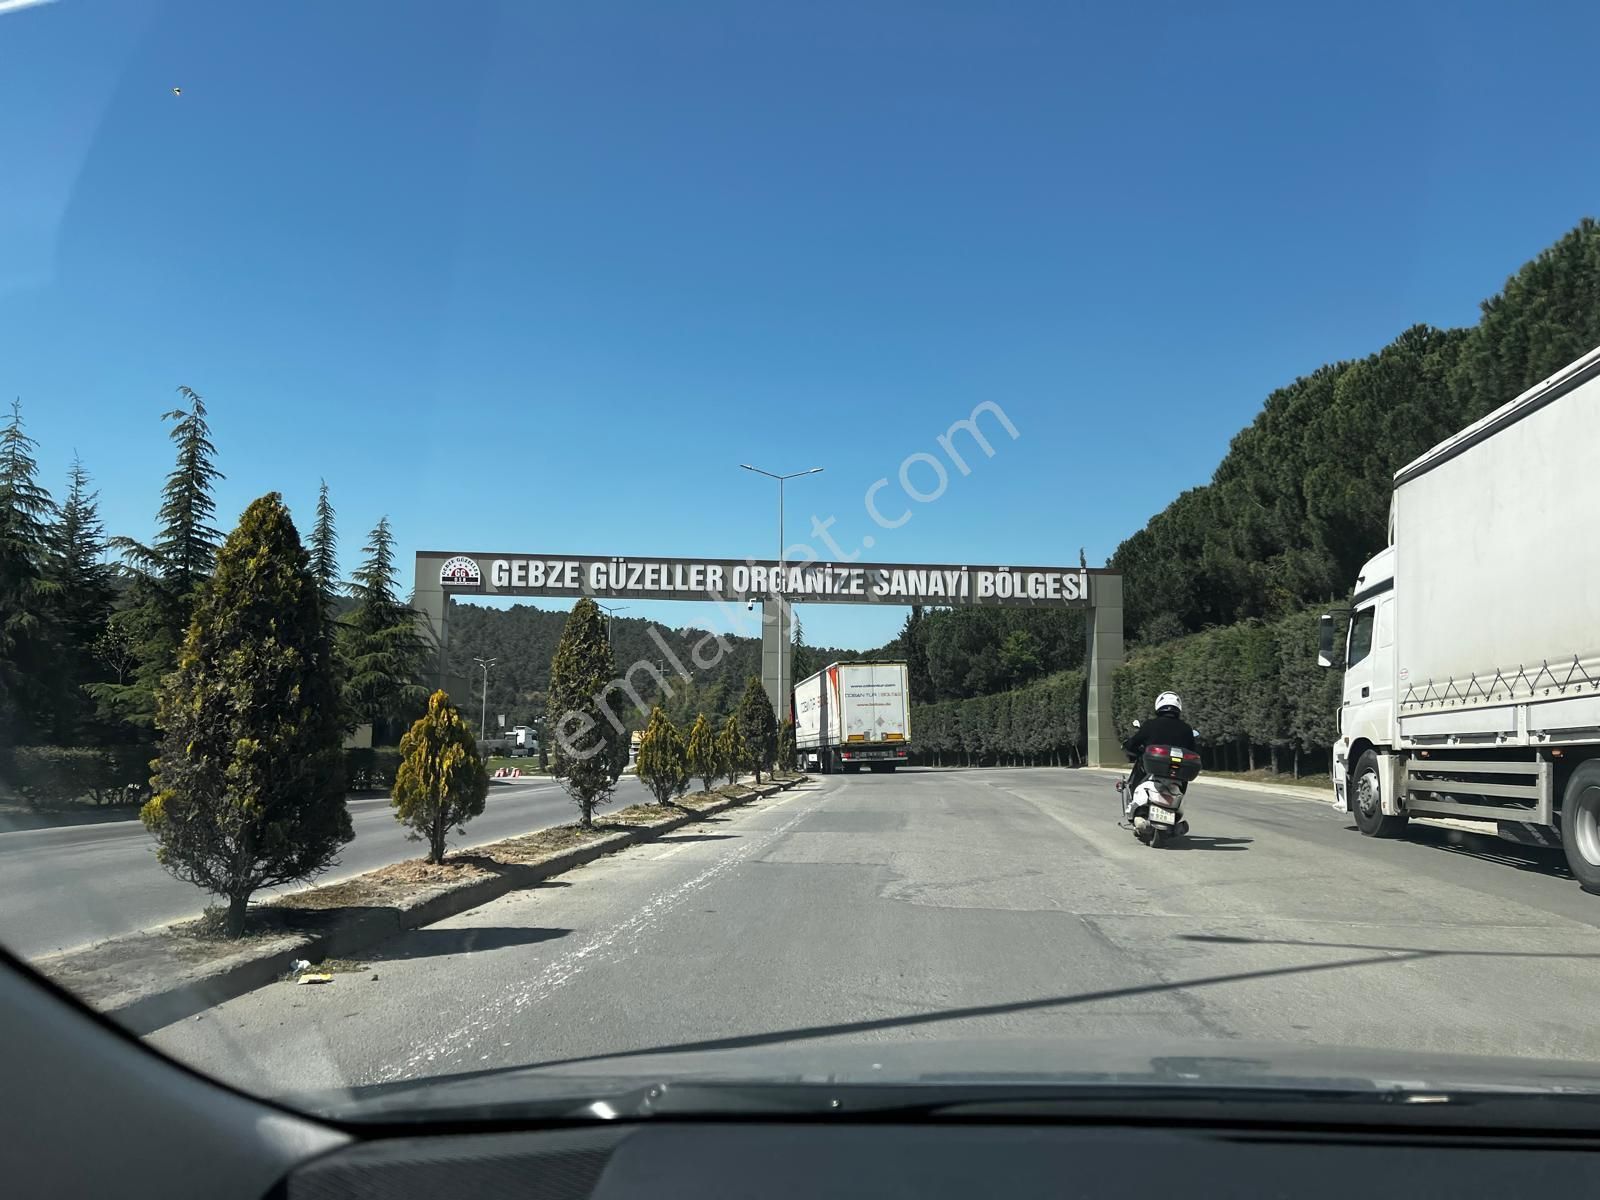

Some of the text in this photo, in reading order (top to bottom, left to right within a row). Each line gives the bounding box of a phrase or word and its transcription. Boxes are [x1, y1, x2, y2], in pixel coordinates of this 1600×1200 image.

[491, 557, 1088, 600] GEBZE GÜZELLER ORGANİZE SANAYİ BÖLGESİ
